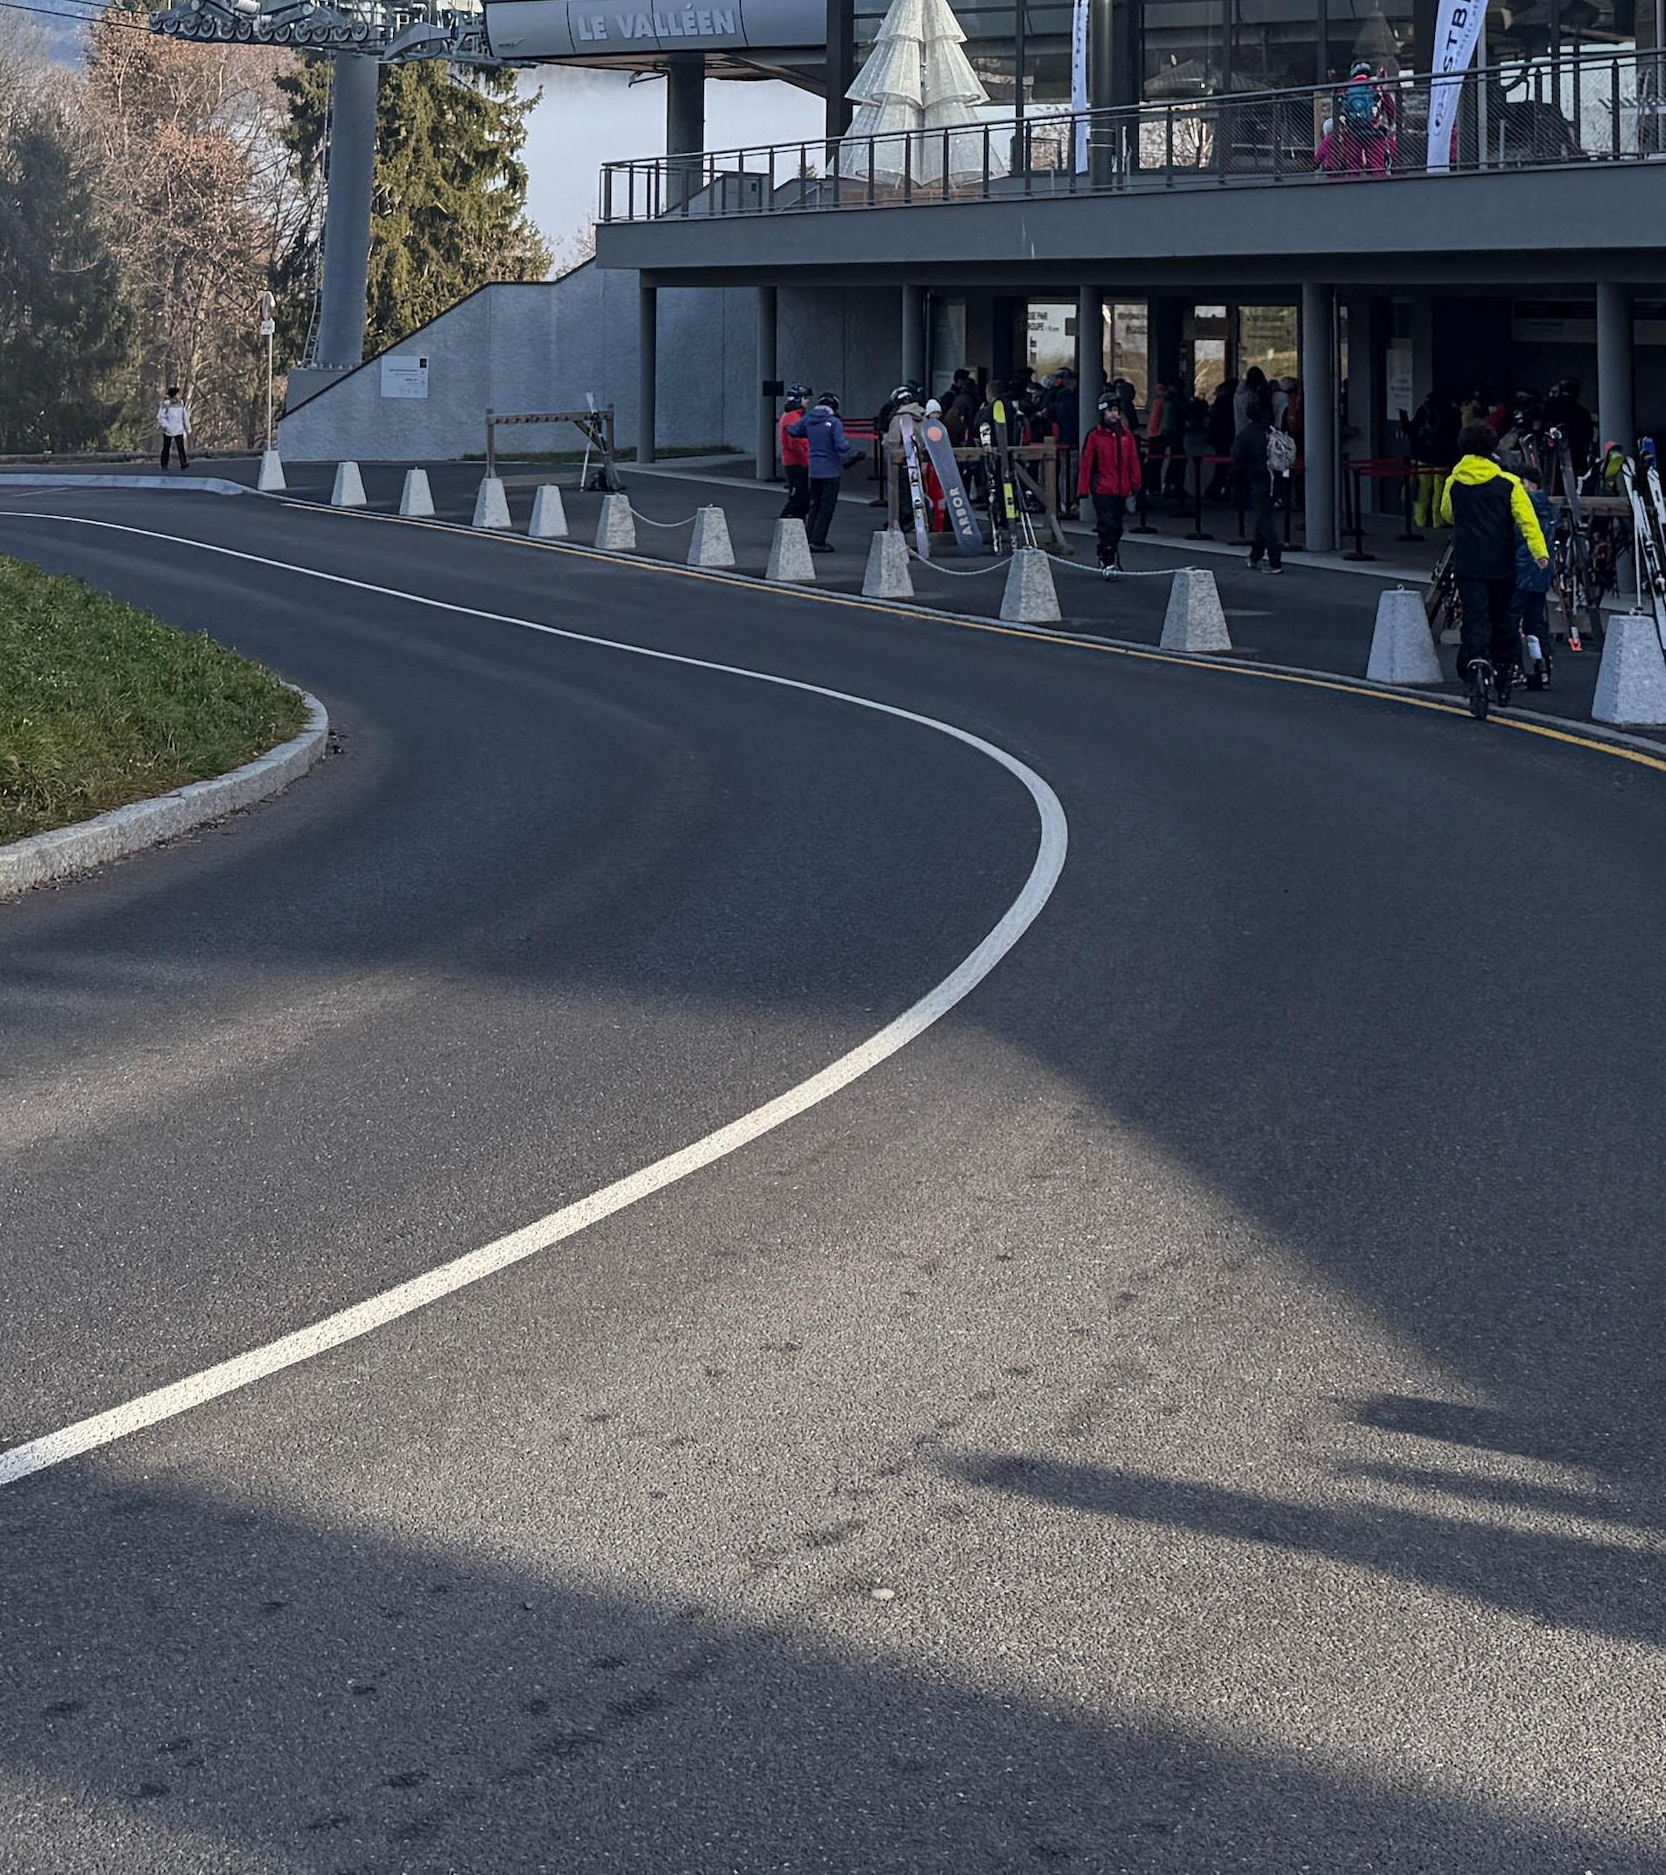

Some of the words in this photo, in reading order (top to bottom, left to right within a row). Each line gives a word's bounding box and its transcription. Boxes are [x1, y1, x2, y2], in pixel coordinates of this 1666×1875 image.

[577, 16, 609, 41] LE
[616, 2, 736, 39] VALLÉEN
[949, 486, 973, 536] ARBOR
